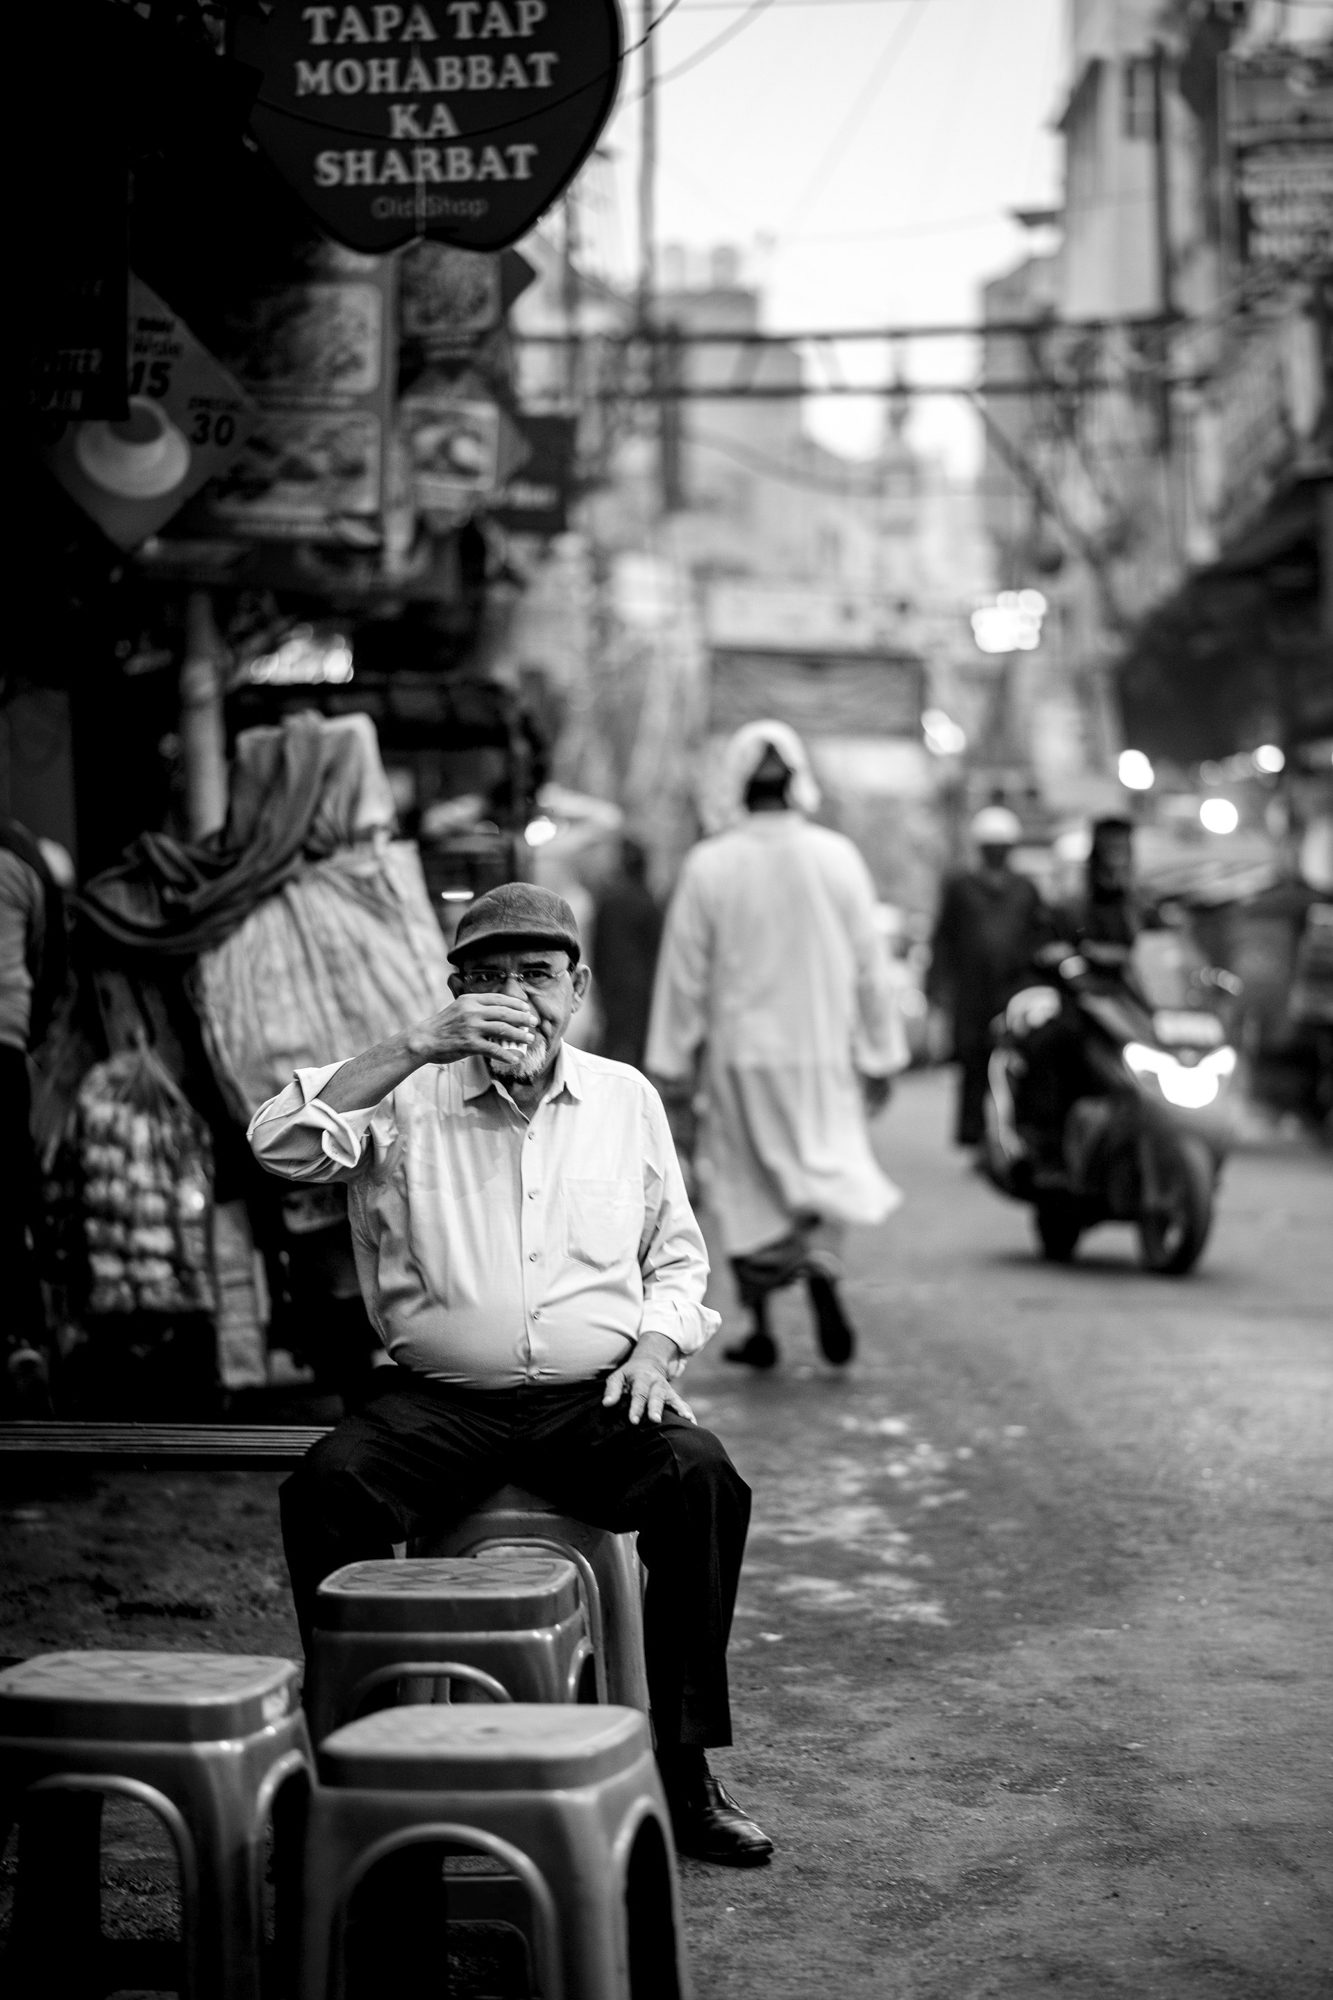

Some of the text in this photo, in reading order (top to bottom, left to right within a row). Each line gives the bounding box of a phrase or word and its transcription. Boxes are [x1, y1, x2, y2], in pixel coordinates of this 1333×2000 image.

[302, 0, 547, 45] TAPA TAP
[294, 51, 560, 96] MOHABBAT
[388, 103, 461, 139] KA
[313, 143, 539, 188] SHARBAT
[191, 413, 235, 447] 30
